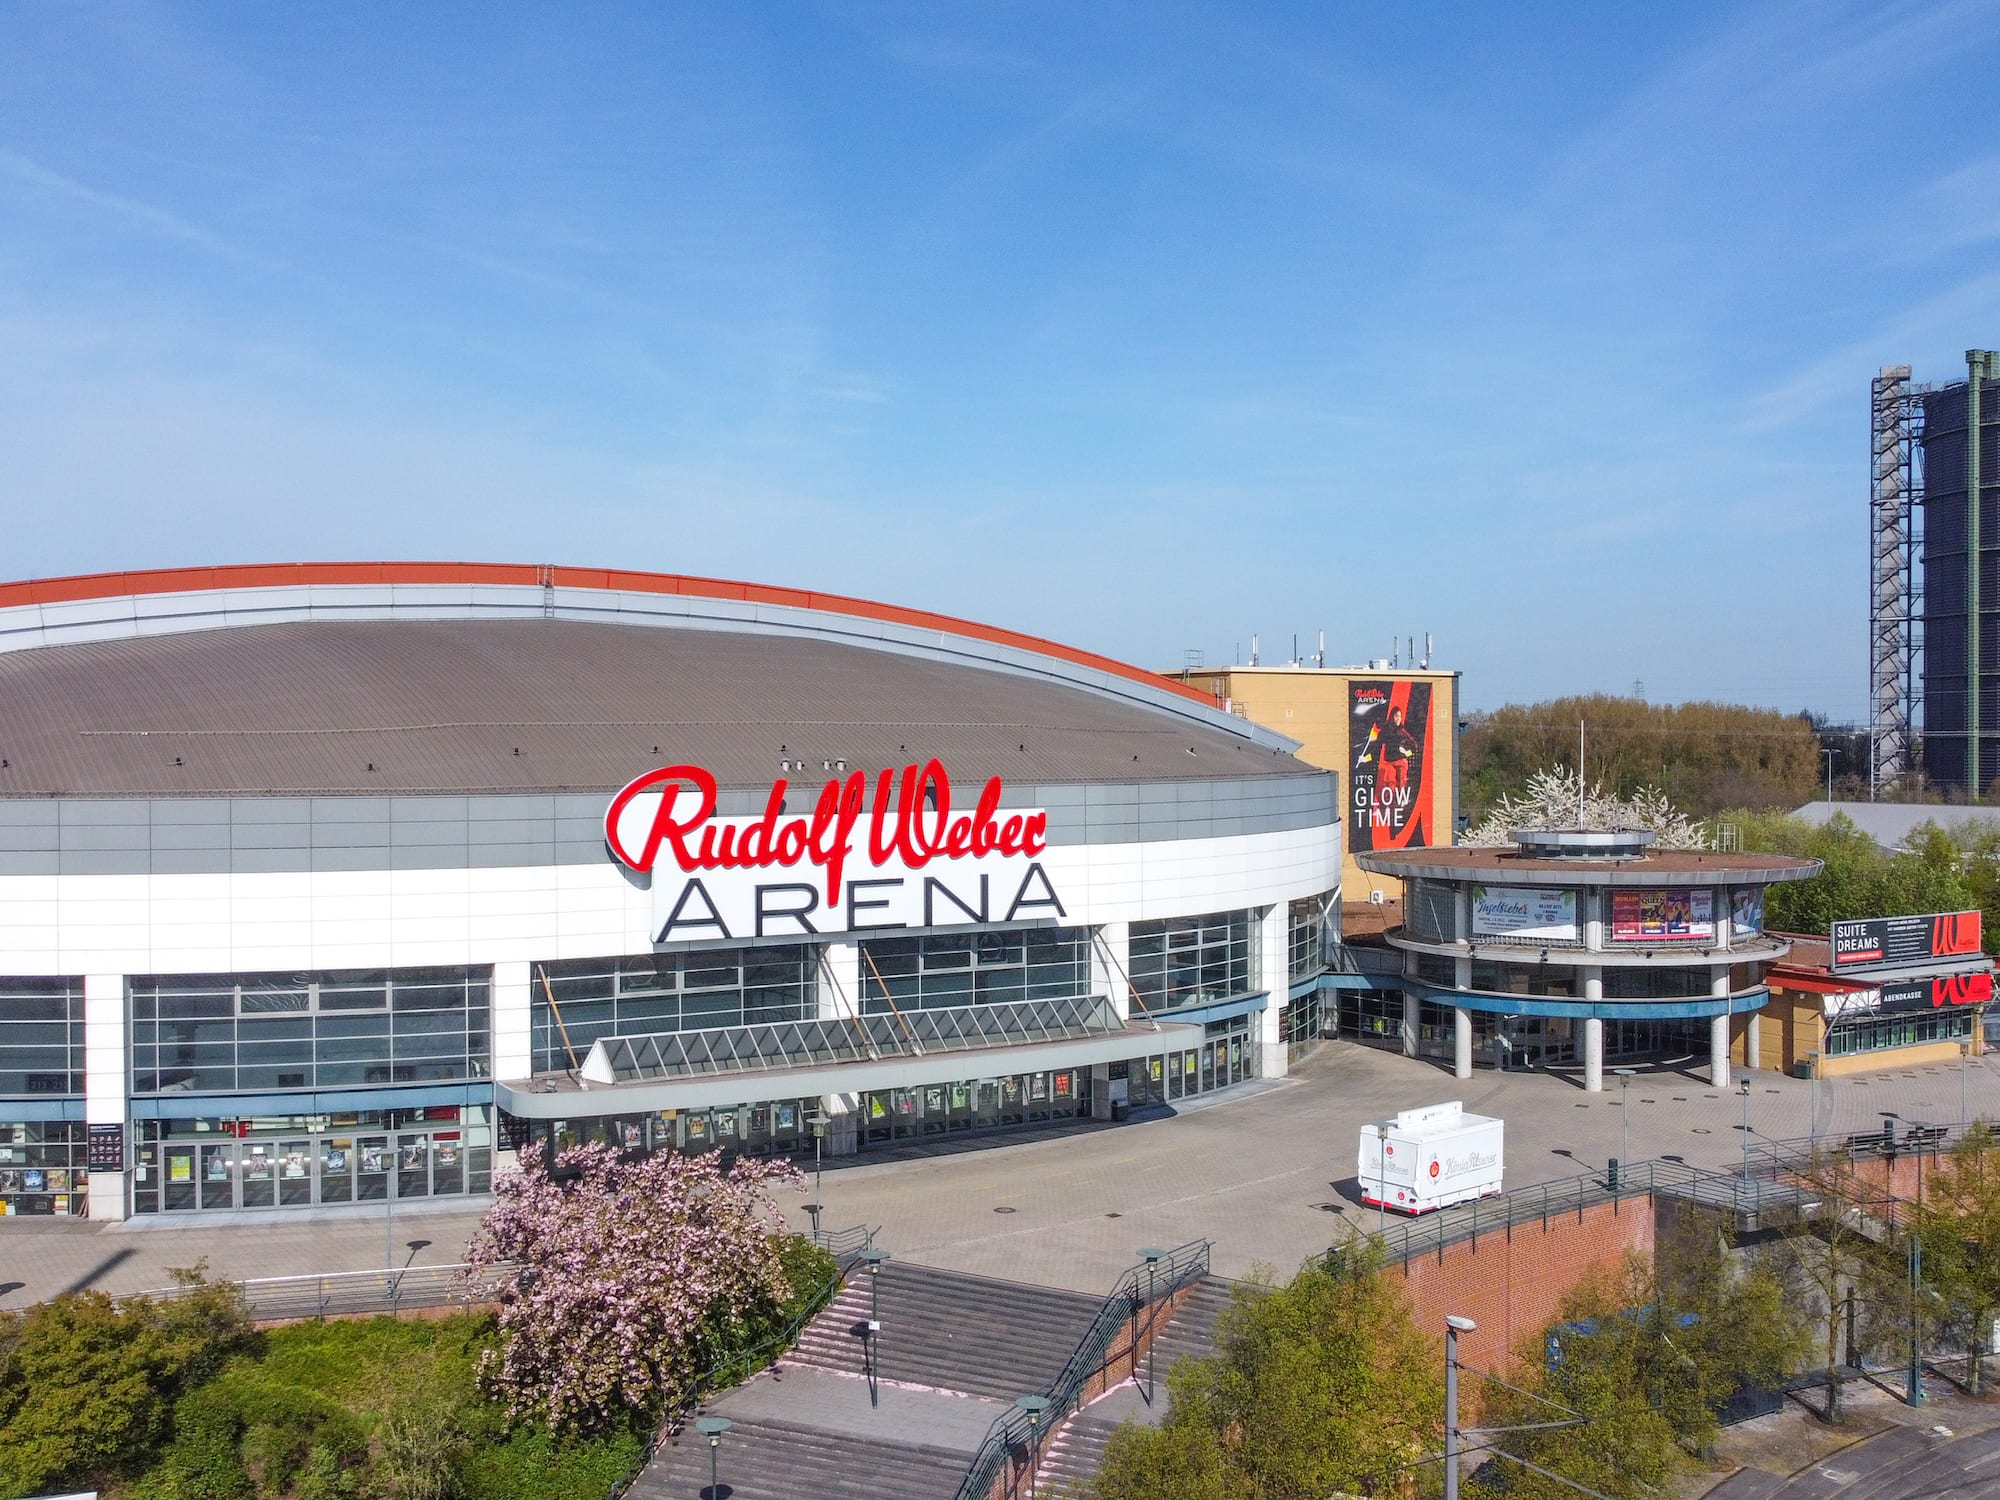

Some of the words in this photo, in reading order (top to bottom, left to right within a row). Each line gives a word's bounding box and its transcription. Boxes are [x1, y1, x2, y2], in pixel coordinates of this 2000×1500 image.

[1355, 775, 1374, 785] IT'S
[1355, 786, 1411, 807] GLOW
[1354, 807, 1404, 828] TIME
[605, 764, 864, 908] Rudolf
[868, 757, 1047, 869] Weber
[656, 862, 1067, 943] ARENA
[1837, 923, 1867, 938] SUITE
[1837, 936, 1879, 951] DREAMS
[1883, 990, 1923, 1002] ABENDKASSE
